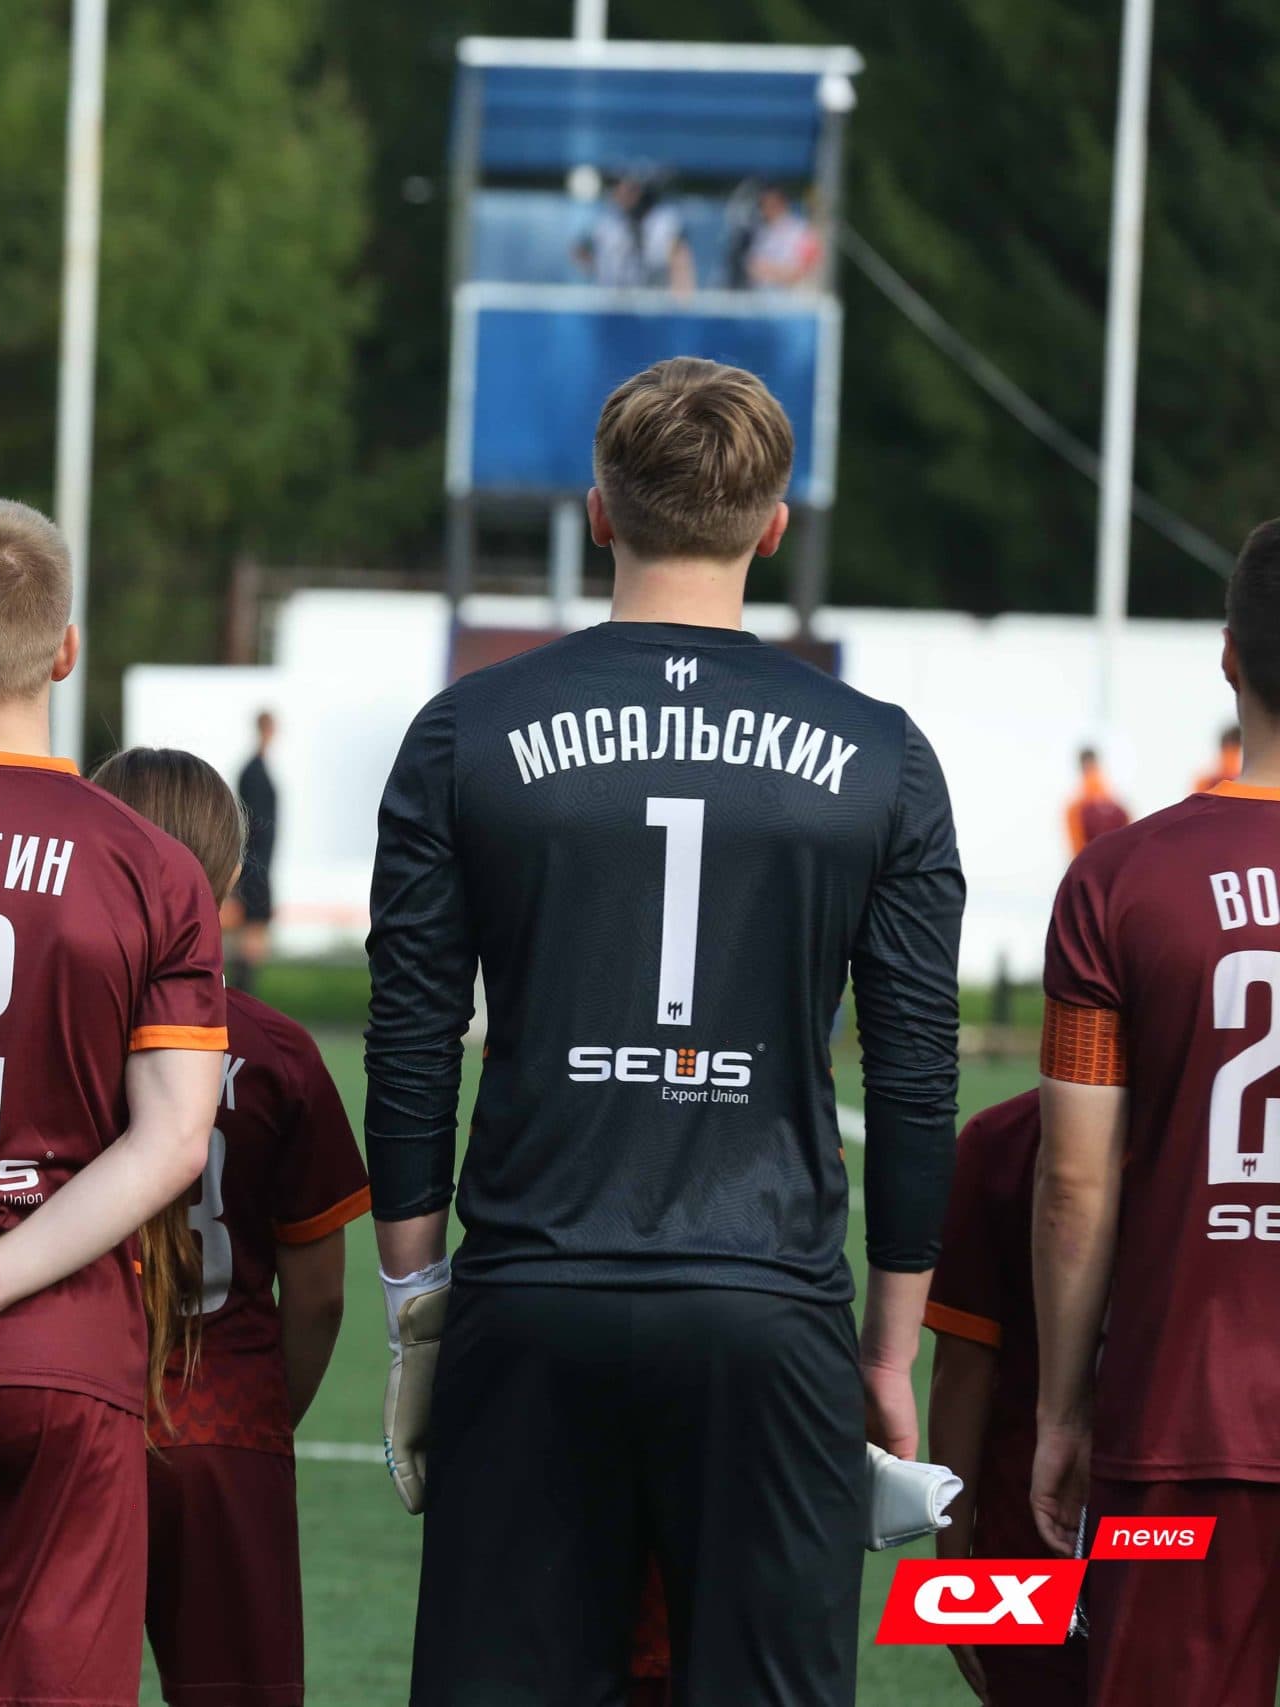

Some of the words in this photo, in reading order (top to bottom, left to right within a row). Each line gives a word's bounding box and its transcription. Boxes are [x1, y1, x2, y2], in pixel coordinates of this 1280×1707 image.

[508, 706, 859, 794] МАСАЛЬСКИХ
[646, 797, 705, 1026] 1
[568, 1047, 753, 1087] SEUS
[662, 1087, 708, 1104] Export
[711, 1090, 749, 1105] Union
